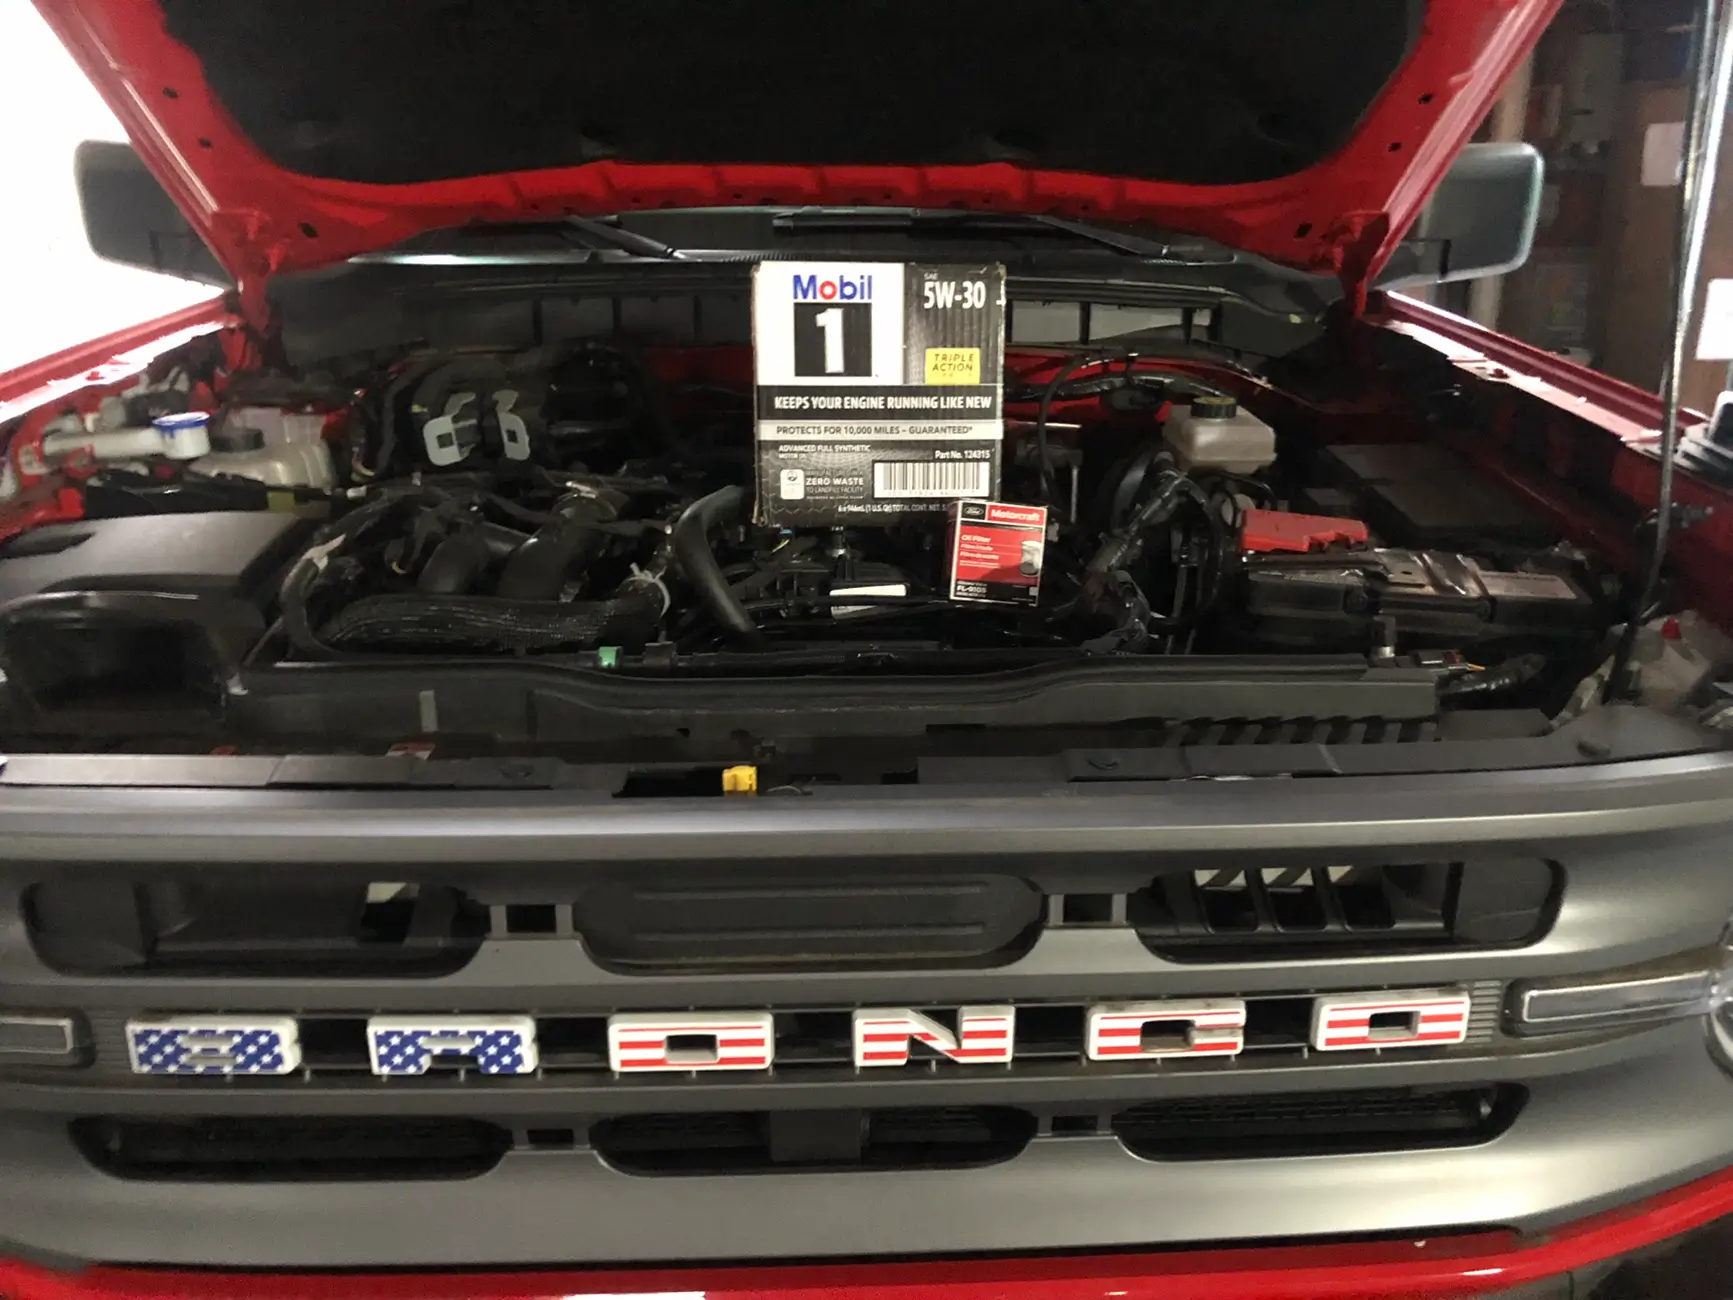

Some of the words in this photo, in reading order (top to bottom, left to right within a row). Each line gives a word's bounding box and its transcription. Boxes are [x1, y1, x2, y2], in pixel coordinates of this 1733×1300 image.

[923, 272, 938, 280] SAE
[793, 274, 873, 300] Mobil
[923, 280, 986, 309] 5W-30
[815, 307, 844, 374] 1
[934, 353, 974, 362] TRIPLE
[932, 363, 973, 371] ACTION
[774, 396, 810, 409] KEEPS
[810, 396, 842, 409] YOUR
[843, 396, 885, 409] ENGINE
[886, 396, 938, 409] RUNNING
[940, 396, 964, 409] LIKE
[965, 396, 992, 409] NEW
[776, 426, 822, 435] PROTECTS
[823, 426, 842, 435] FOR
[844, 426, 872, 436] 10,000
[874, 426, 900, 435] MILES
[778, 444, 817, 452] ADVANCED
[817, 444, 833, 452] FULL
[834, 444, 871, 452] SYNTHETIC
[935, 450, 950, 459] Part
[950, 450, 963, 459] No.
[963, 450, 991, 459] 124315
[805, 477, 831, 486] ZERO
[832, 477, 864, 486] WASTE
[965, 507, 983, 515] Ford
[991, 509, 1040, 522] Motorcraft
[972, 535, 991, 543] Filter
[125, 987, 1472, 1076] BRONCO
